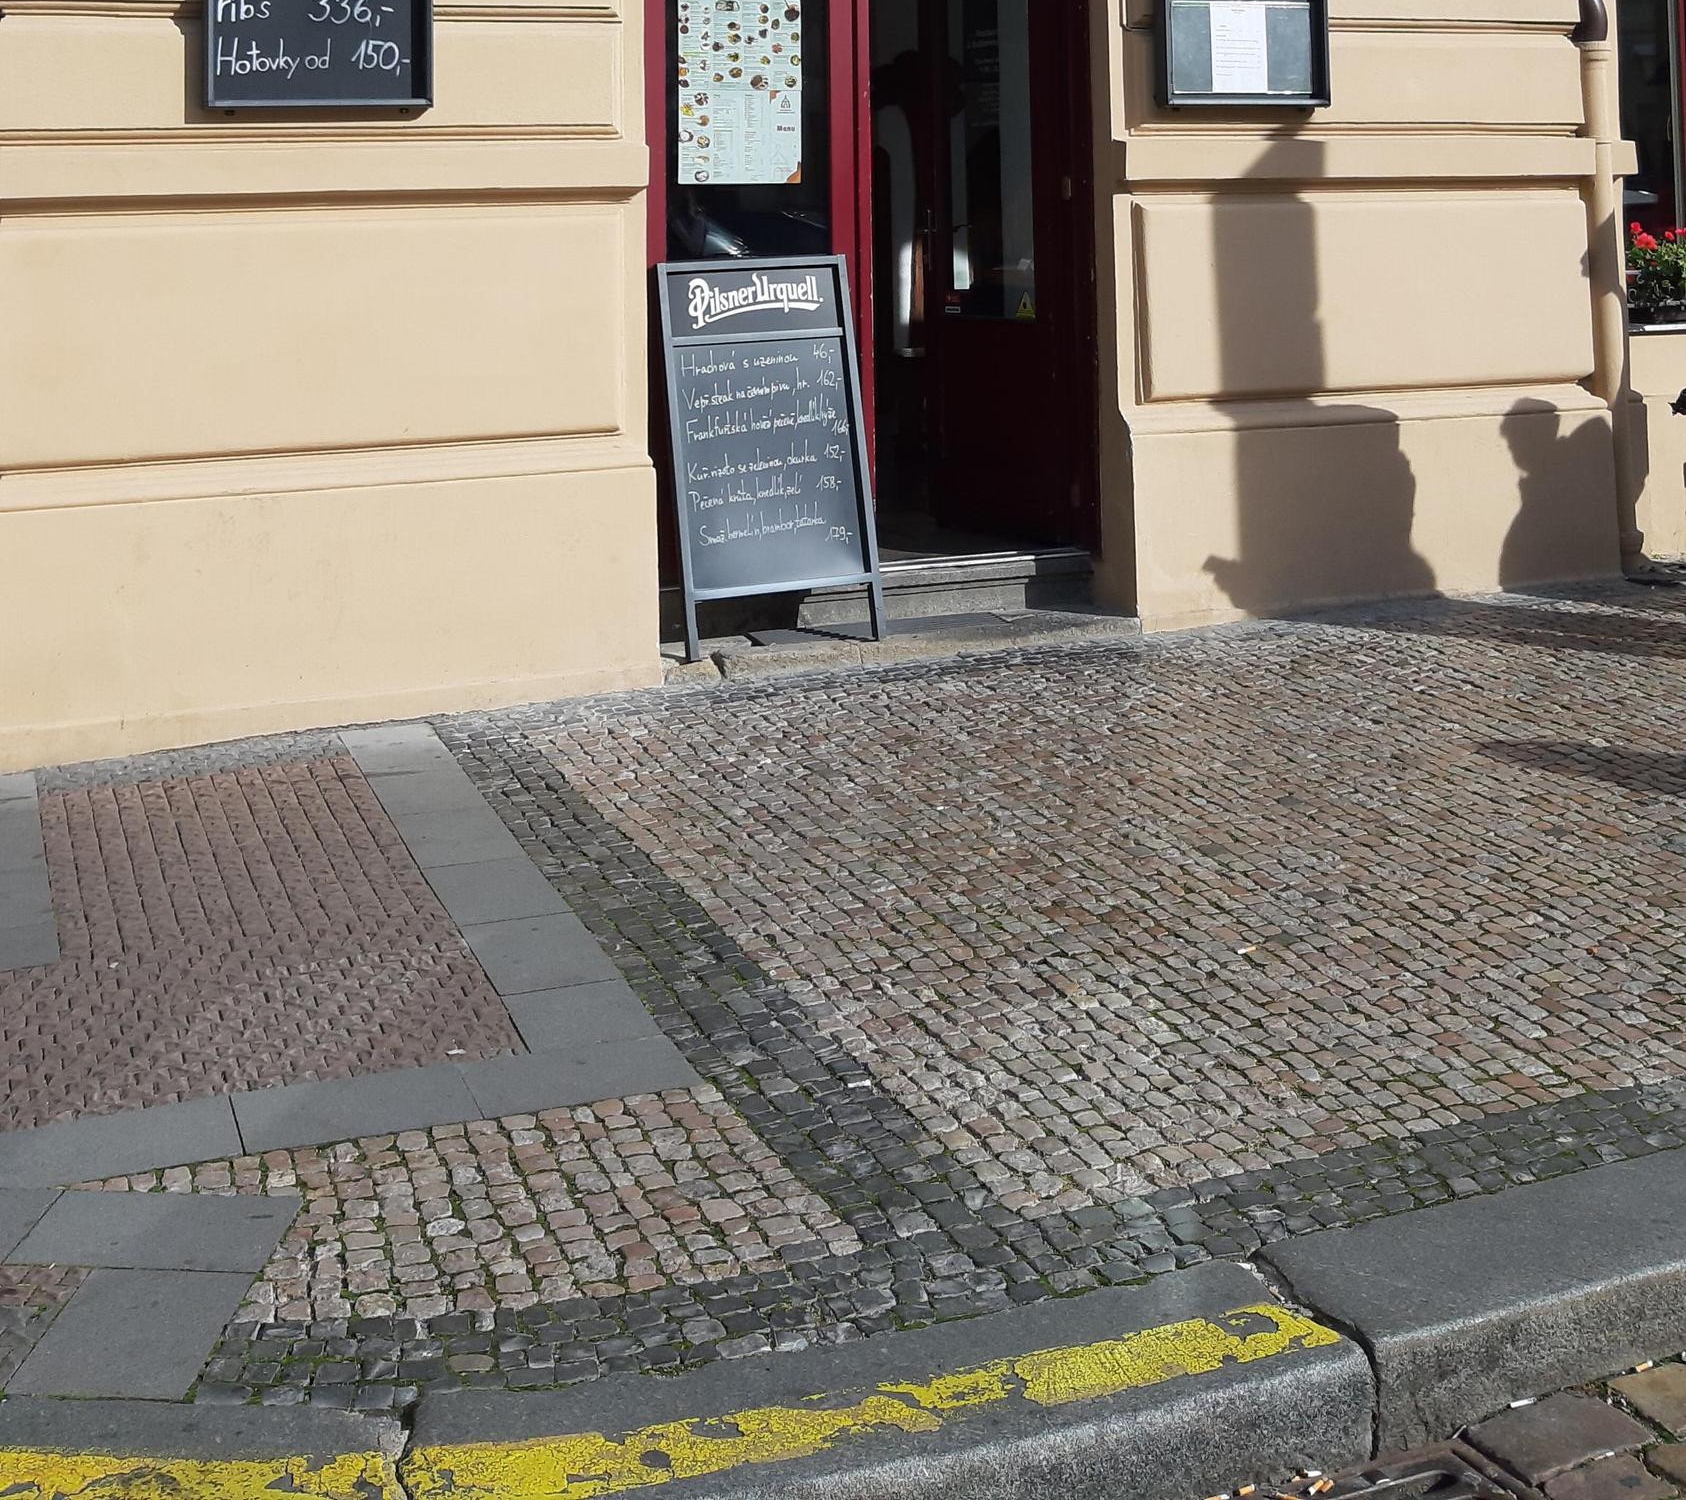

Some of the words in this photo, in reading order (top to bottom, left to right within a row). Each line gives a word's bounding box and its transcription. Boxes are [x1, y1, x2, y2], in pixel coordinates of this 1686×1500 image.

[305, 38, 330, 69] od
[688, 278, 756, 329] Pilsner
[743, 359, 750, 369] s
